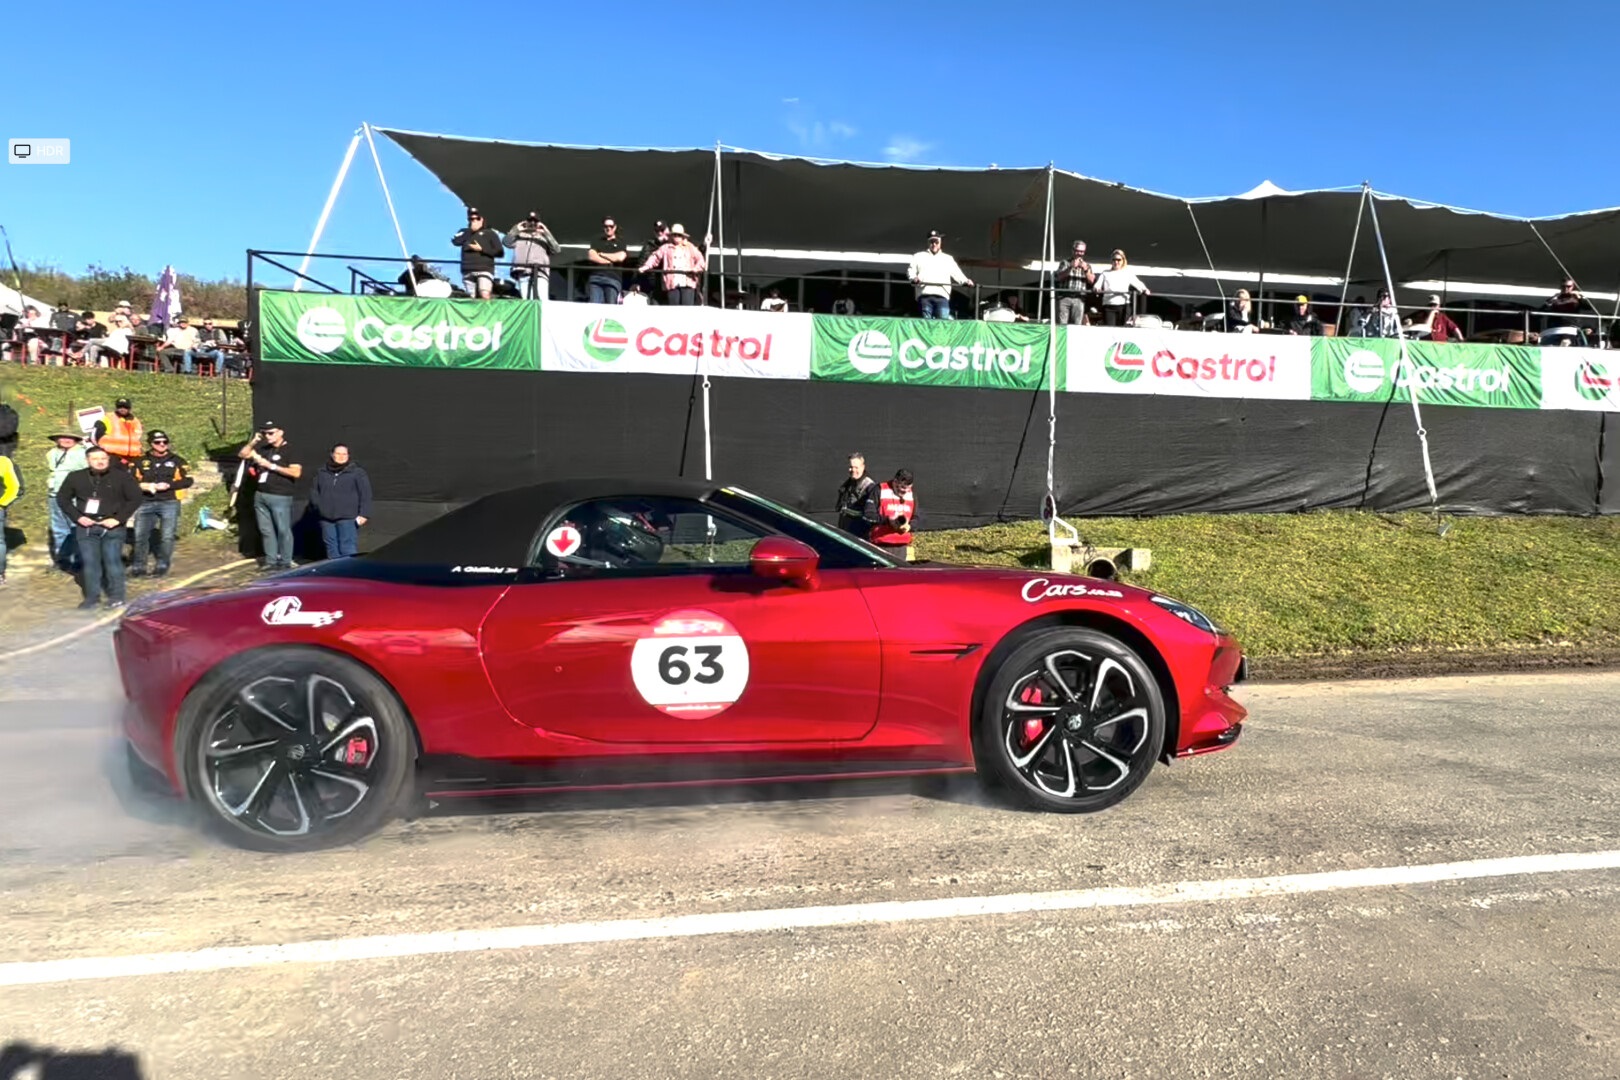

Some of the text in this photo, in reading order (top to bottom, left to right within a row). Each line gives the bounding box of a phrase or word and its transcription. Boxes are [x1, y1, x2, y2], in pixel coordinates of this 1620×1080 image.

[354, 316, 503, 351] Castrol
[635, 326, 772, 361] Castrol
[899, 338, 1032, 373] Castrol
[1151, 349, 1276, 382] Castrol
[657, 645, 725, 686] 63
